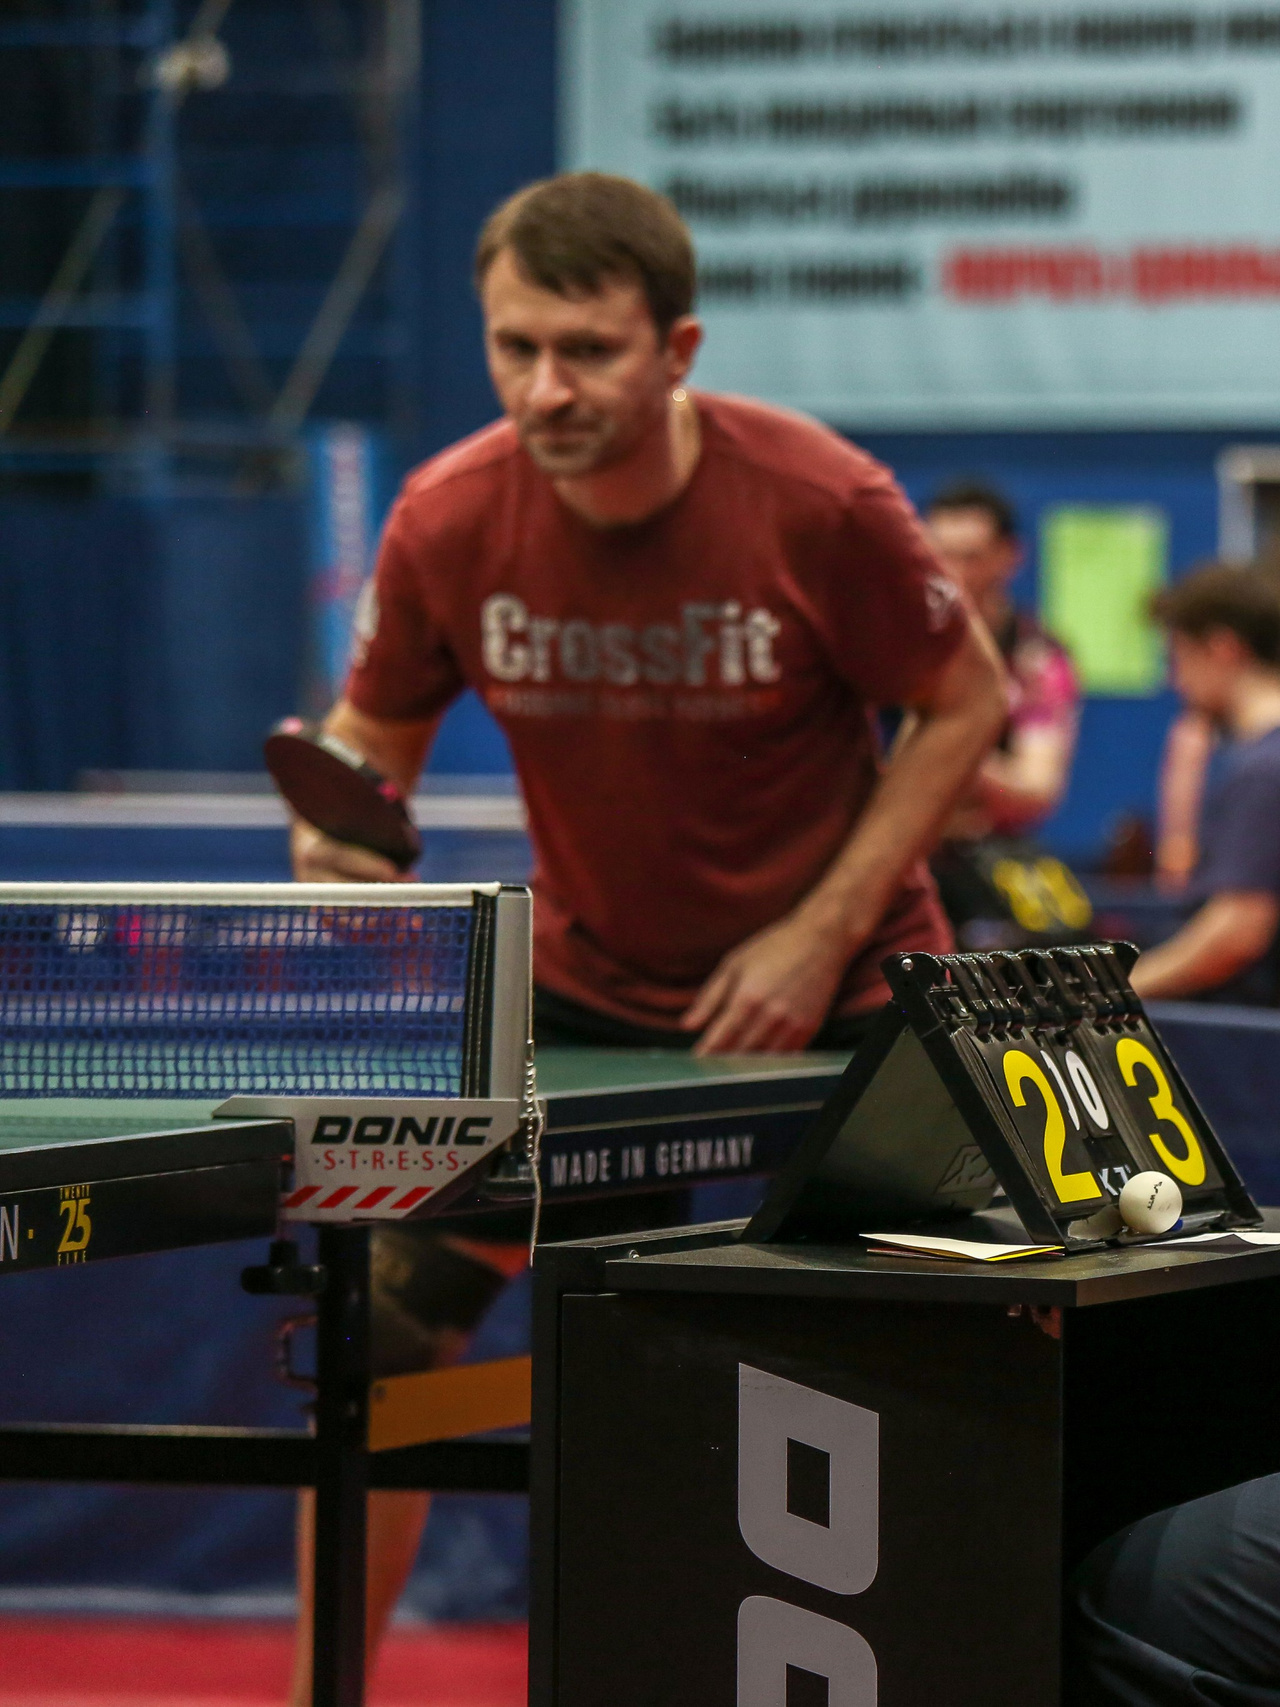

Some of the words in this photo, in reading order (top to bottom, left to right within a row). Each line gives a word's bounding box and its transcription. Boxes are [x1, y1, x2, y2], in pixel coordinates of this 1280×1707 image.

[480, 593, 782, 687] CrossFit
[311, 1115, 493, 1146] DONIC
[1003, 1050, 1102, 1203] 2
[1116, 1038, 1206, 1186] 3
[551, 1152, 611, 1187] MADE
[621, 1145, 646, 1180] IN
[655, 1134, 755, 1177] GERMANY
[57, 1197, 92, 1253] 25
[57, 1250, 87, 1267] FIVE
